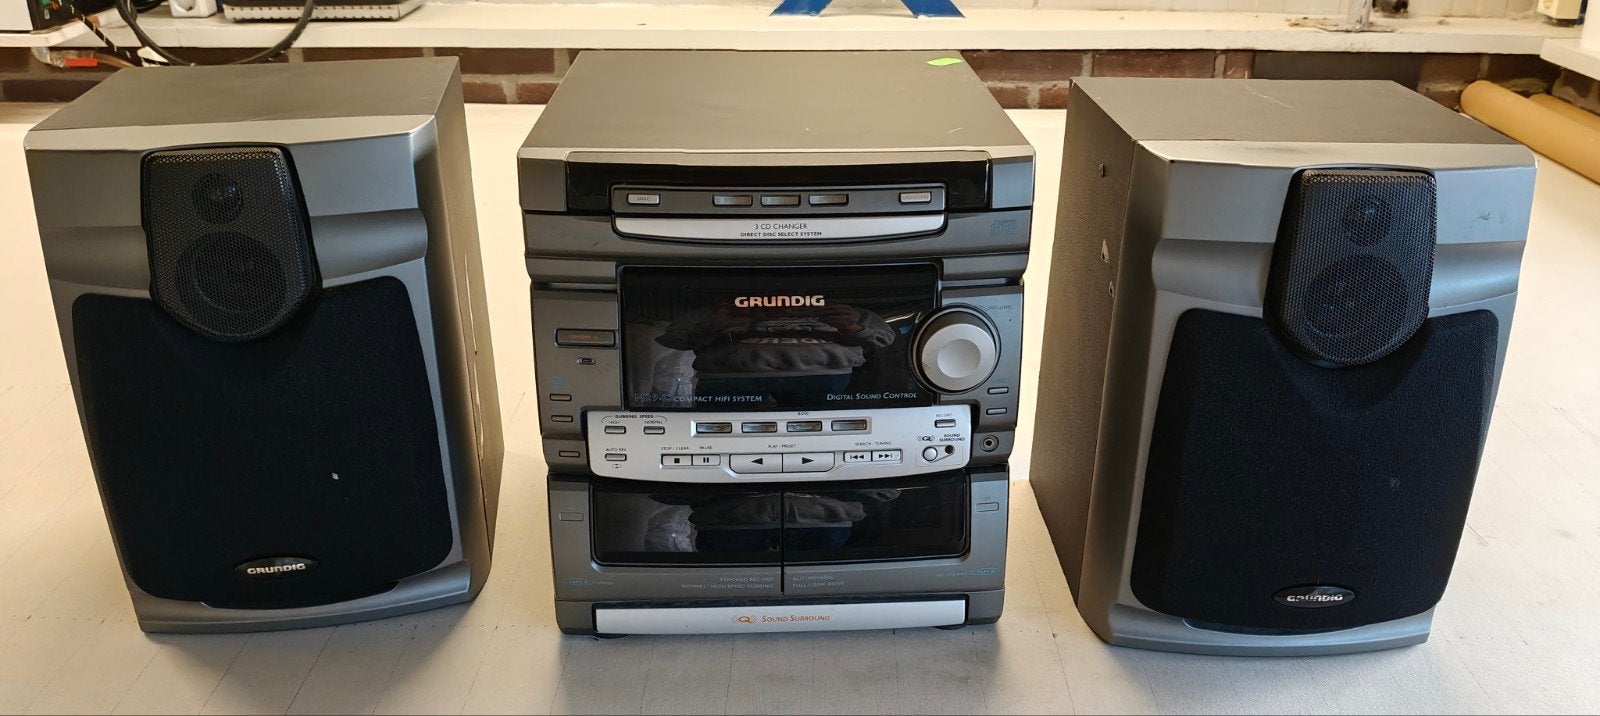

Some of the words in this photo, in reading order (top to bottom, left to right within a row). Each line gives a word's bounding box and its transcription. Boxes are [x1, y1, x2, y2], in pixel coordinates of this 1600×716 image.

[773, 222, 808, 230] CHANGER
[734, 295, 825, 308] GRUNDIG
[826, 393, 854, 401] DIGITAL
[855, 392, 881, 400] SOUND
[883, 391, 917, 400] CONTROL
[247, 563, 306, 574] GRUNDIG
[790, 614, 830, 622] SURROUND
